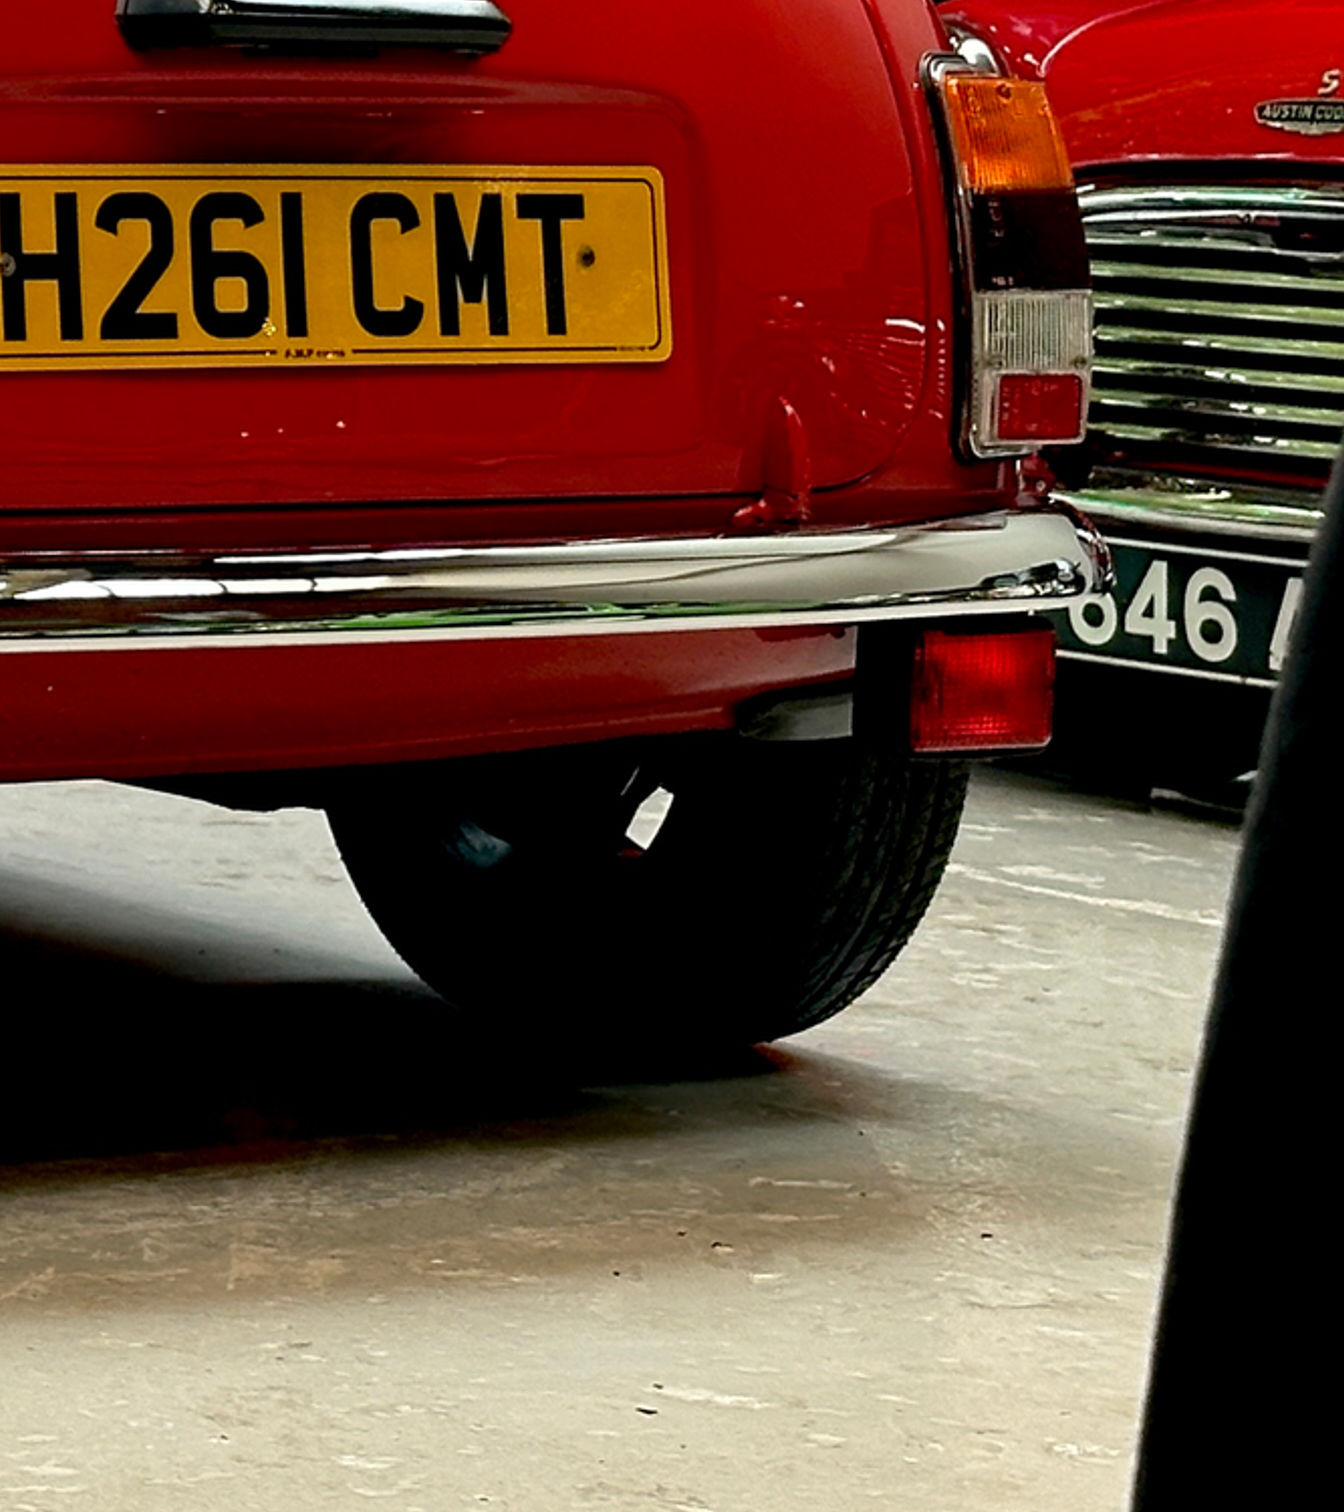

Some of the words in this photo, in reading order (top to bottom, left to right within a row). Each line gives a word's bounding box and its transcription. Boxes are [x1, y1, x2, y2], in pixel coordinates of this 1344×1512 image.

[1317, 69, 1340, 95] S
[1262, 104, 1313, 119] AUSTIN
[350, 192, 585, 336] CMT
